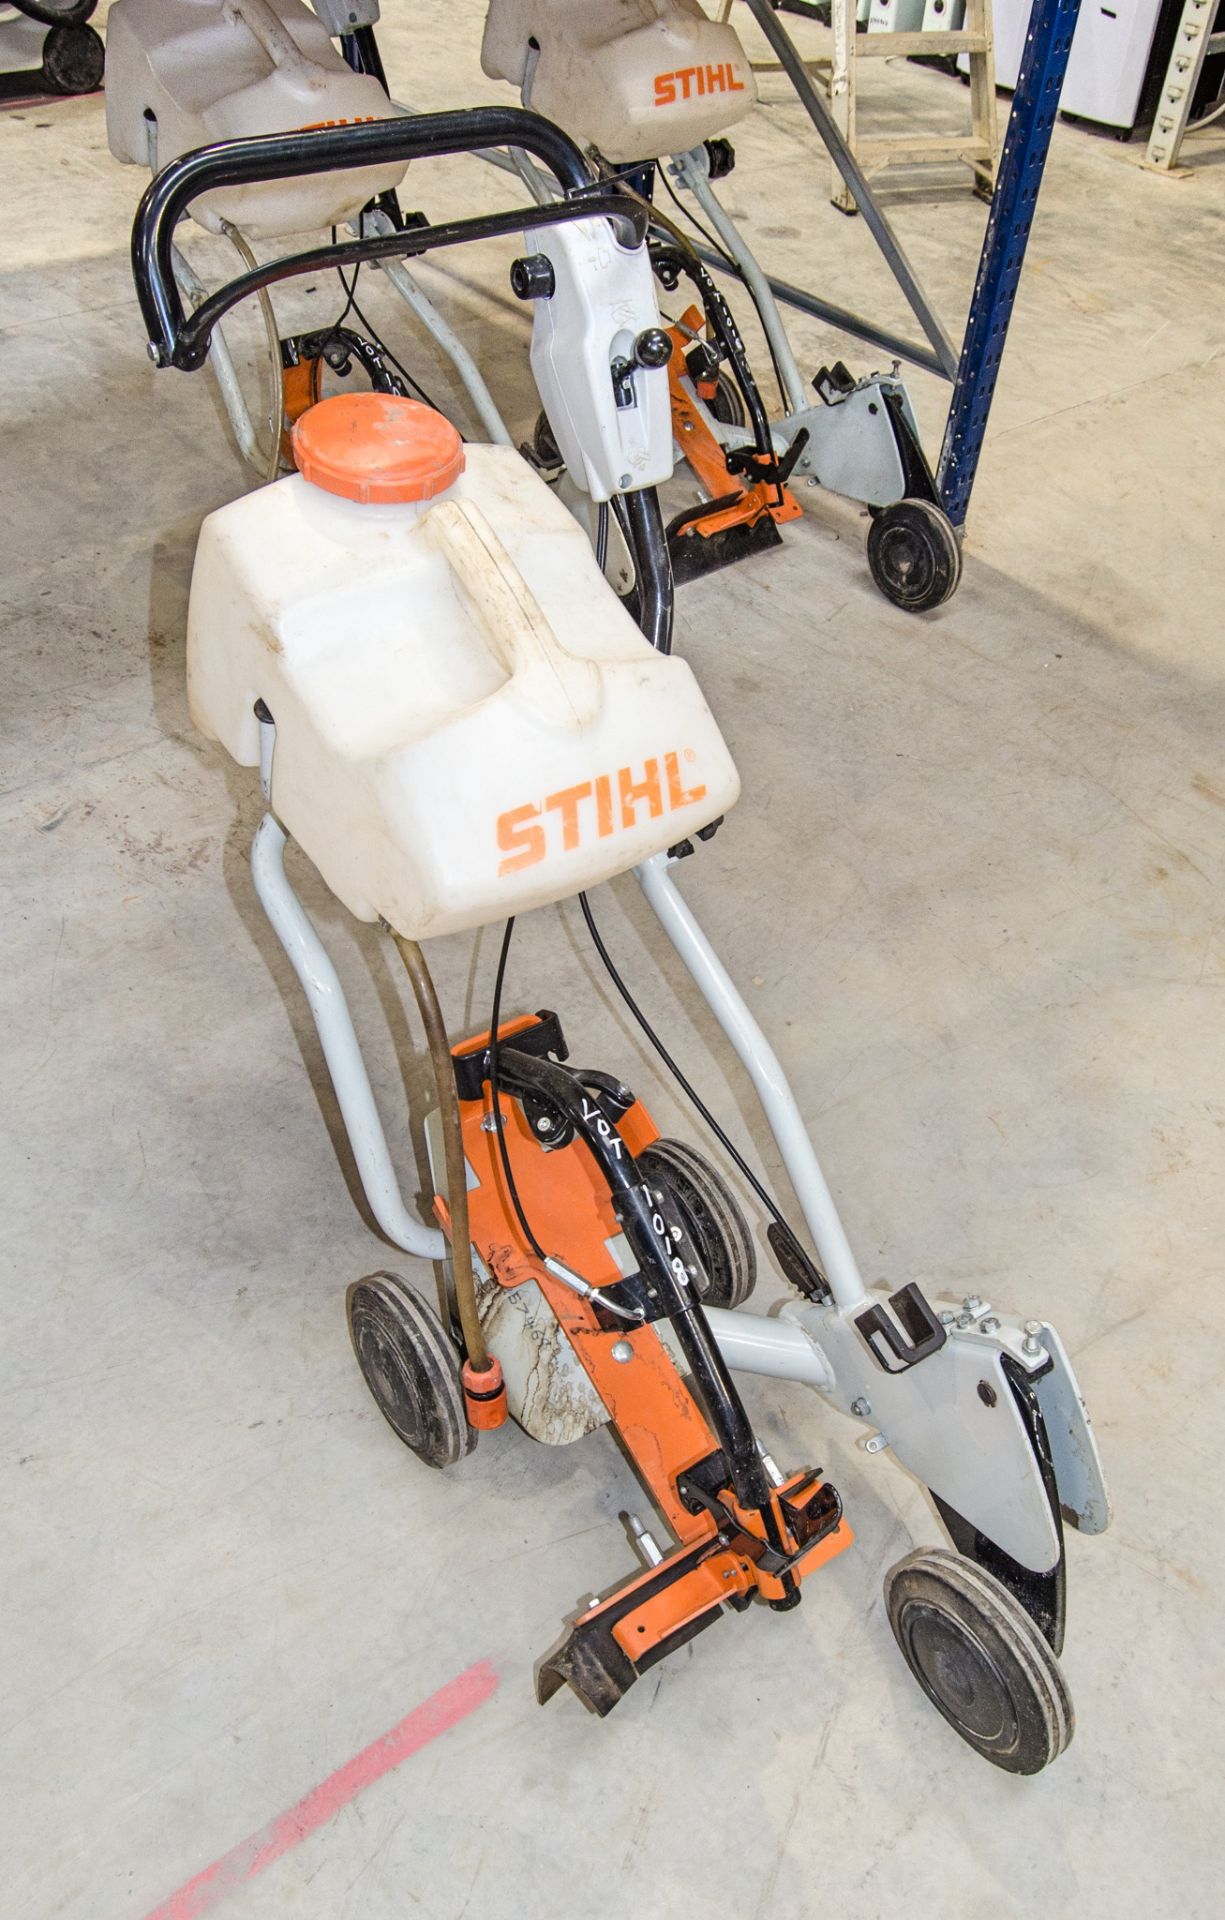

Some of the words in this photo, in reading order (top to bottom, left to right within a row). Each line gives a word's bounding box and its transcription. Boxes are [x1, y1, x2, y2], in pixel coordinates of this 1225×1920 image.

[655, 63, 744, 106] STIHL
[700, 267, 721, 303] LOT
[357, 336, 382, 368] LOT
[385, 373, 400, 396] 10
[497, 751, 707, 877] STIHL
[582, 1098, 623, 1160] LOT
